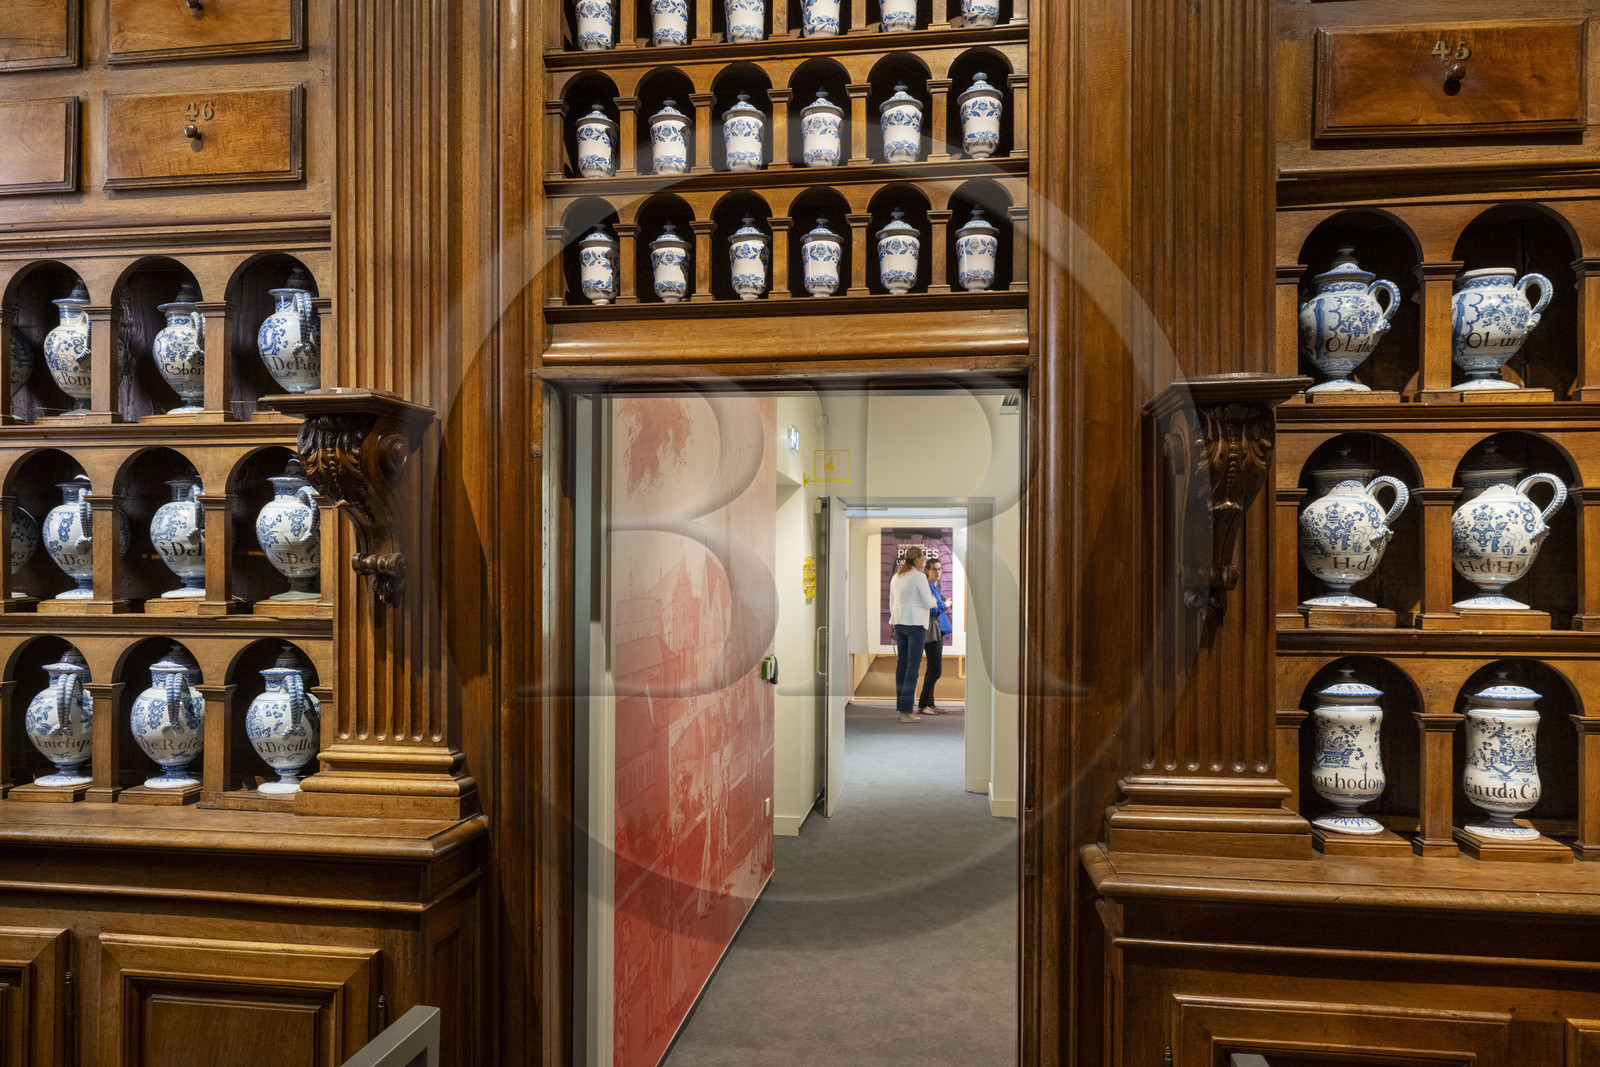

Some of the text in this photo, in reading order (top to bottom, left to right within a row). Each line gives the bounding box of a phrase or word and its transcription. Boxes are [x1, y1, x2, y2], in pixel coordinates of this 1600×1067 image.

[1431, 40, 1472, 62] 45
[184, 101, 215, 122] 46
[897, 548, 939, 559] PTES
